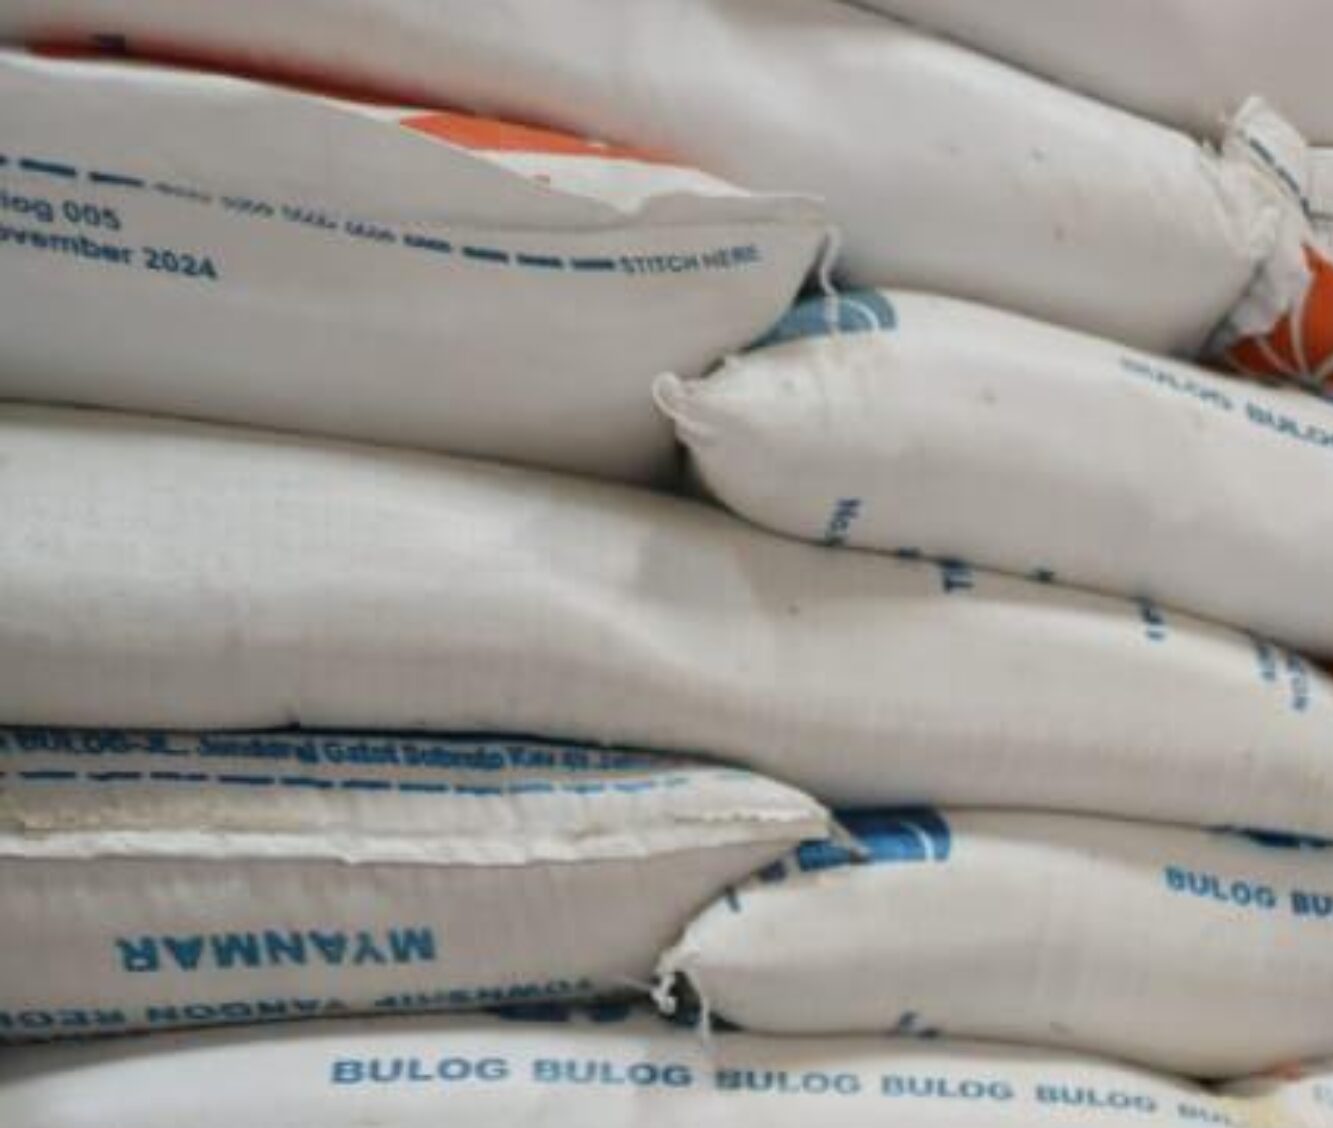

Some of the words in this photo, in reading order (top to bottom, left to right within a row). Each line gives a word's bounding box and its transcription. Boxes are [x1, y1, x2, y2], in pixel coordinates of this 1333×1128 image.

[62, 200, 121, 231] 005
[0, 226, 131, 265] ovember
[142, 245, 217, 281] 2024
[1164, 864, 1277, 912] BULOG
[114, 927, 437, 973] MYANMAR
[330, 1055, 510, 1086] BULOG
[531, 1057, 694, 1090] BULOG
[714, 1067, 862, 1097] BULOG
[880, 1073, 1015, 1103] BULOG
[1035, 1082, 1158, 1115] BULOG
